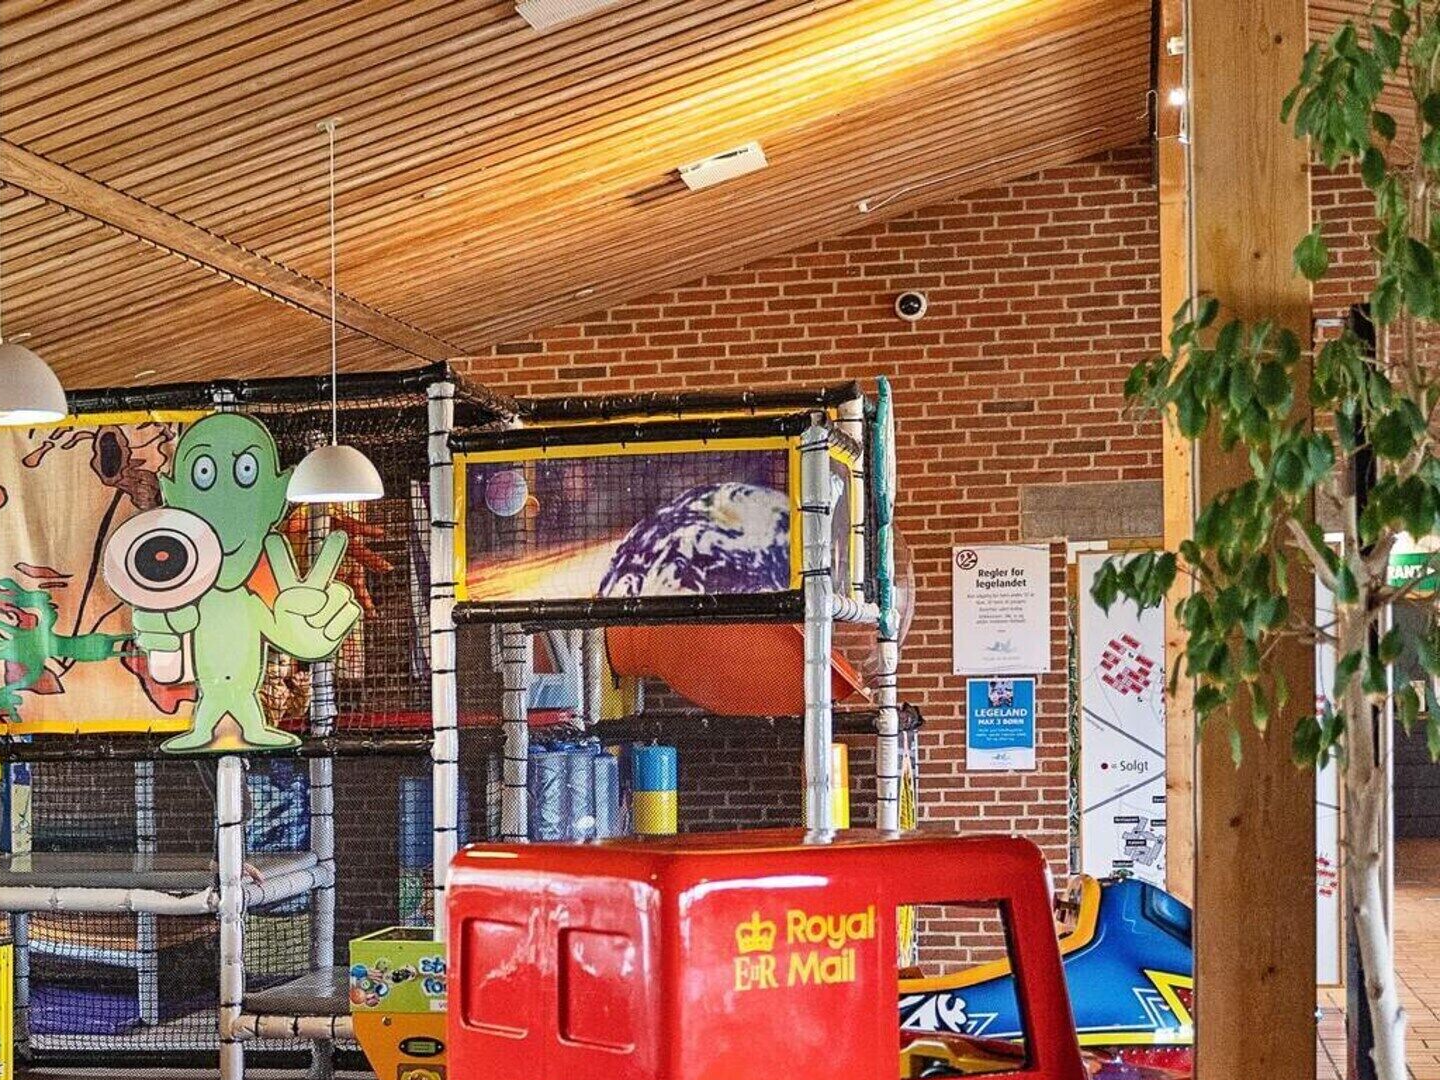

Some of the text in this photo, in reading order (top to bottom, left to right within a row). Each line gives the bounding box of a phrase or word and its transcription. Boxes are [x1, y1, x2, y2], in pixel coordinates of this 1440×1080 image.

[978, 568, 1024, 579] Regler for
[976, 579, 1027, 589] legelandet
[974, 708, 1028, 717] LEGELAND
[1120, 760, 1149, 773] Solgt
[786, 904, 876, 949] Royal
[787, 948, 856, 987] Mail
